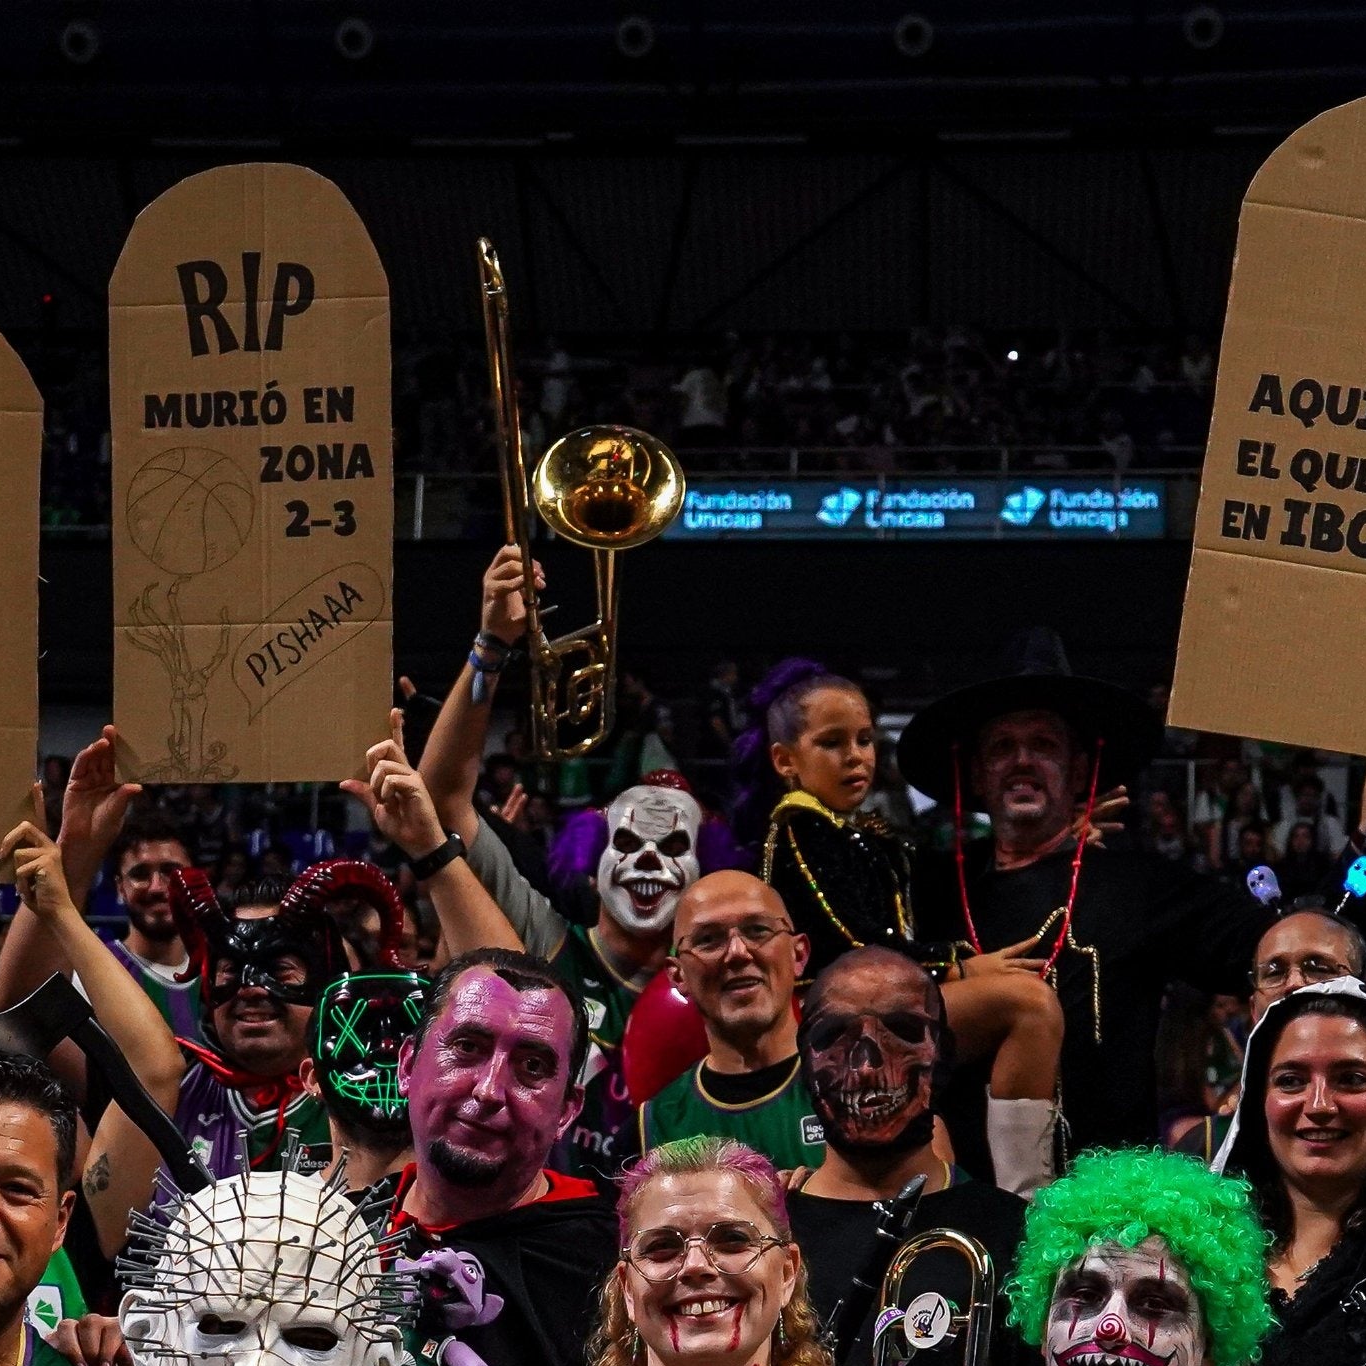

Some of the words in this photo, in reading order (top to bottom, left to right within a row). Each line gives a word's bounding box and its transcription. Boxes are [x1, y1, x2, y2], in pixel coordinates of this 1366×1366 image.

[175, 251, 316, 358] RIP
[143, 380, 287, 429] MURIÓ
[303, 386, 355, 425] EN
[260, 443, 375, 483] ZONA
[1236, 439, 1282, 479] EL
[284, 500, 358, 538] 2-3
[684, 489, 793, 510] Fundación
[1221, 499, 1271, 541] EN
[245, 580, 364, 687] PISHAAA
